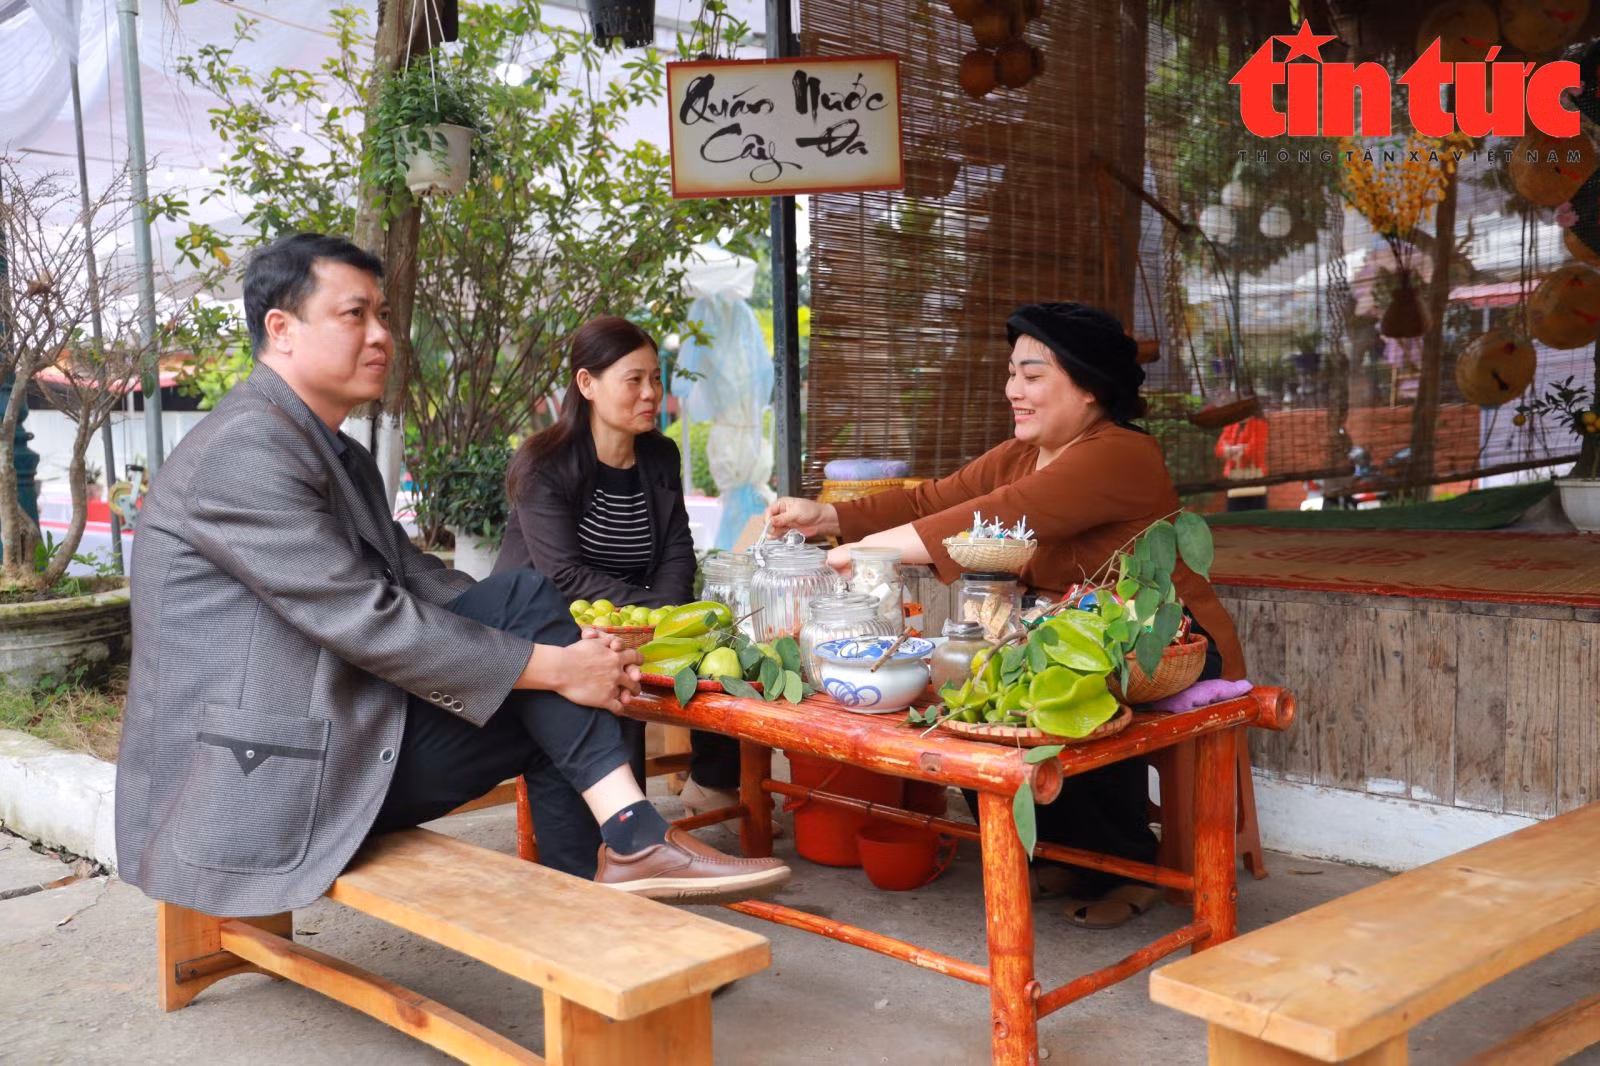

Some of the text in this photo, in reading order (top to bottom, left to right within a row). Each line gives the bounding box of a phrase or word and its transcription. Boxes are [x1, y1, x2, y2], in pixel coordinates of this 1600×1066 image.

[679, 69, 888, 126] Quán Nước
[700, 118, 868, 183] Cây Đa
